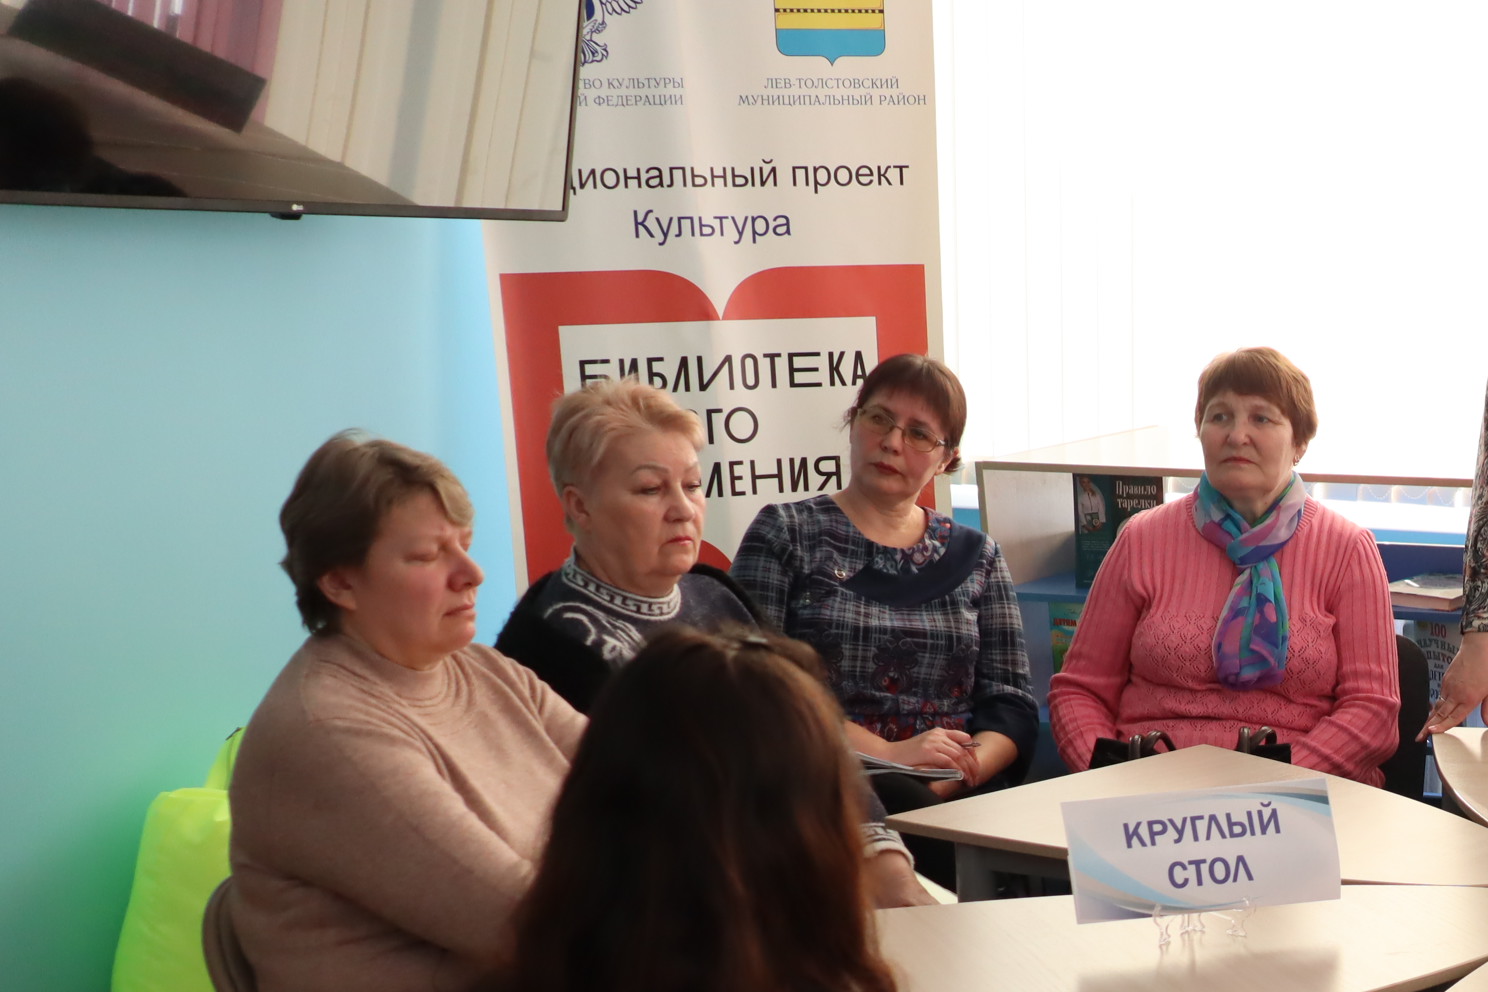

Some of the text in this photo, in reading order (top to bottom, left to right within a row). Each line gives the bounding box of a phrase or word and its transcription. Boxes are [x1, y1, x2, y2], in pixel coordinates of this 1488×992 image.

[607, 77, 685, 90] КУЛЬТУРЫ
[764, 76, 900, 90] ЛЕВ-ТОЛСТОВСКИЙ
[593, 93, 685, 108] ФЕДЕРАЦИИ
[738, 92, 928, 107] МУНИЦИПАЛЬНЫЙ РАЙОН
[791, 164, 910, 195] проект
[633, 208, 792, 247] Культура
[578, 350, 869, 393] БИБЛИОТЕКА
[1115, 480, 1157, 498] Правило
[1116, 498, 1157, 512] тарелки
[1430, 622, 1447, 639] 100
[1122, 801, 1282, 849] КРУГЛЫЙ
[1167, 854, 1255, 889] СТОЛ
